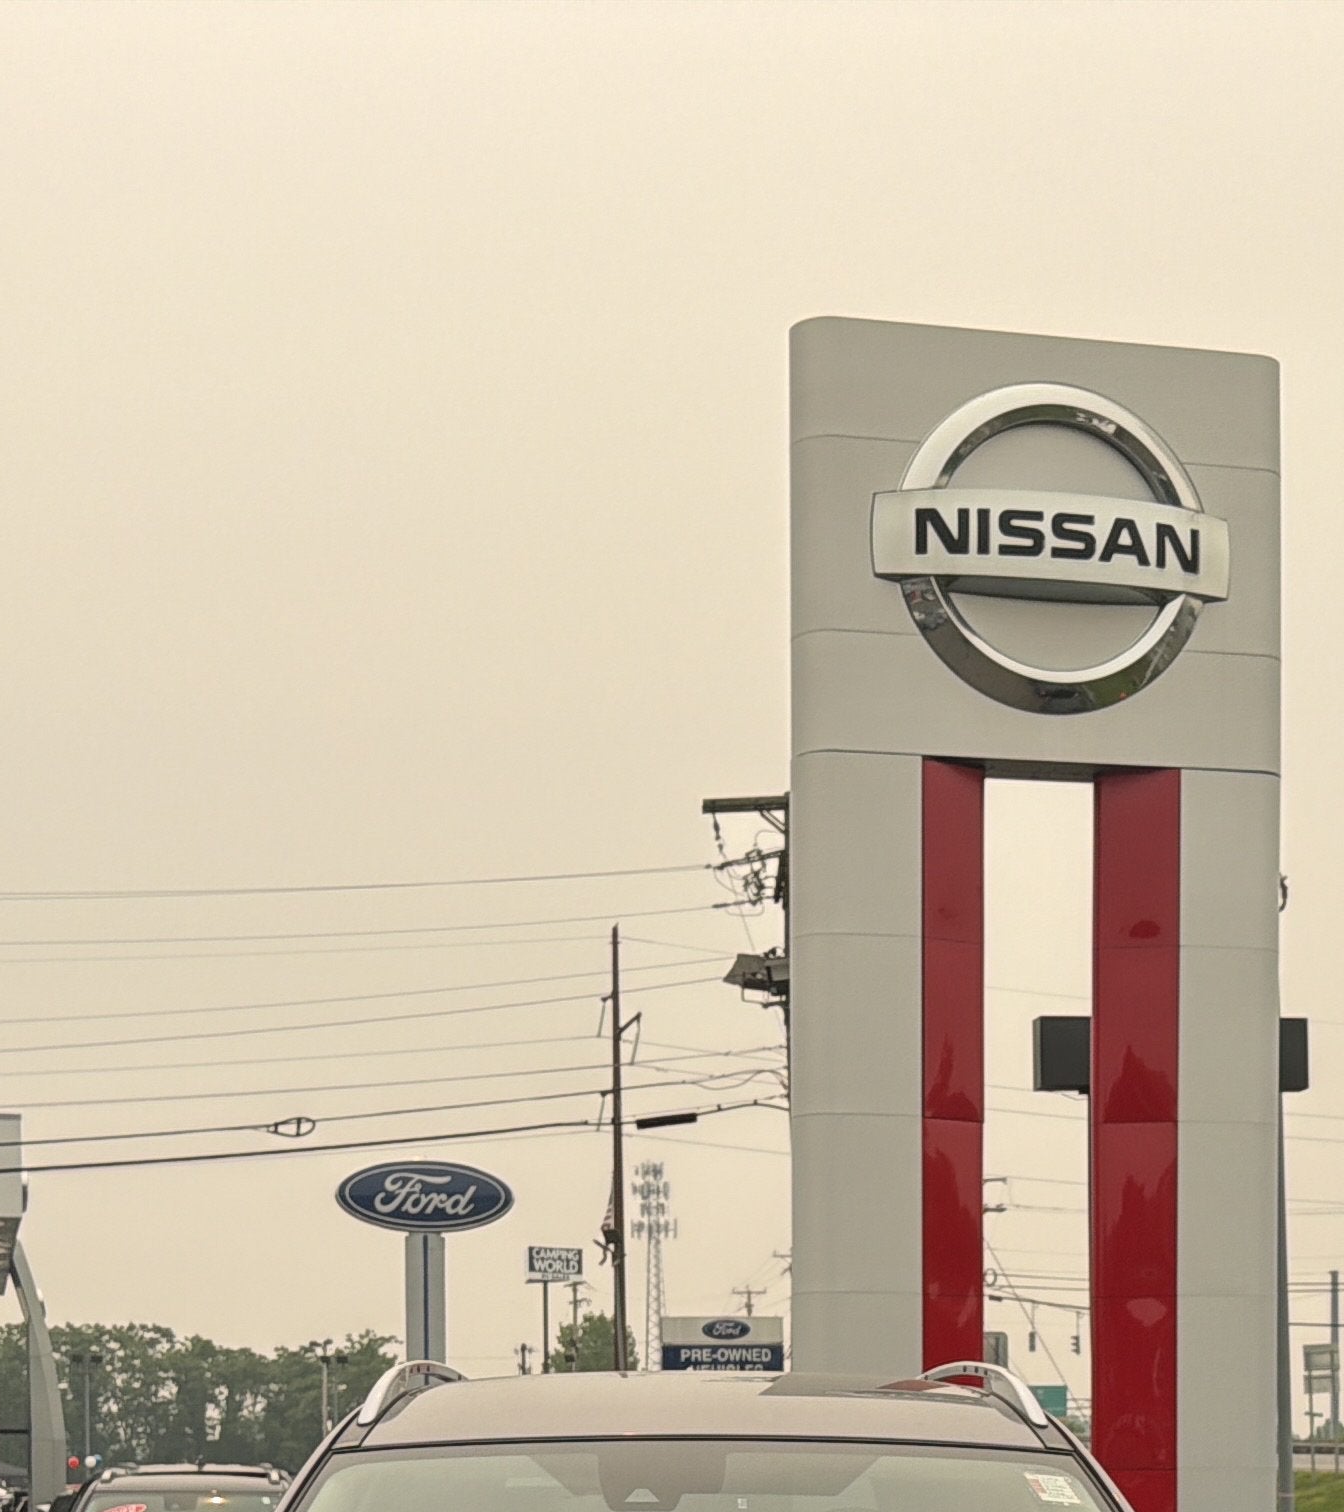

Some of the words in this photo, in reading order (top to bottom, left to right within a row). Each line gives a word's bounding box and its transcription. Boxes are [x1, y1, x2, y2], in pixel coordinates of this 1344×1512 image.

[914, 507, 1201, 575] NISSAN
[373, 1172, 477, 1215] Ford
[532, 1247, 580, 1261] CAMPING
[533, 1258, 579, 1274] WORLD
[712, 1322, 742, 1336] Ford
[679, 1347, 773, 1363] PRE-OWNED
